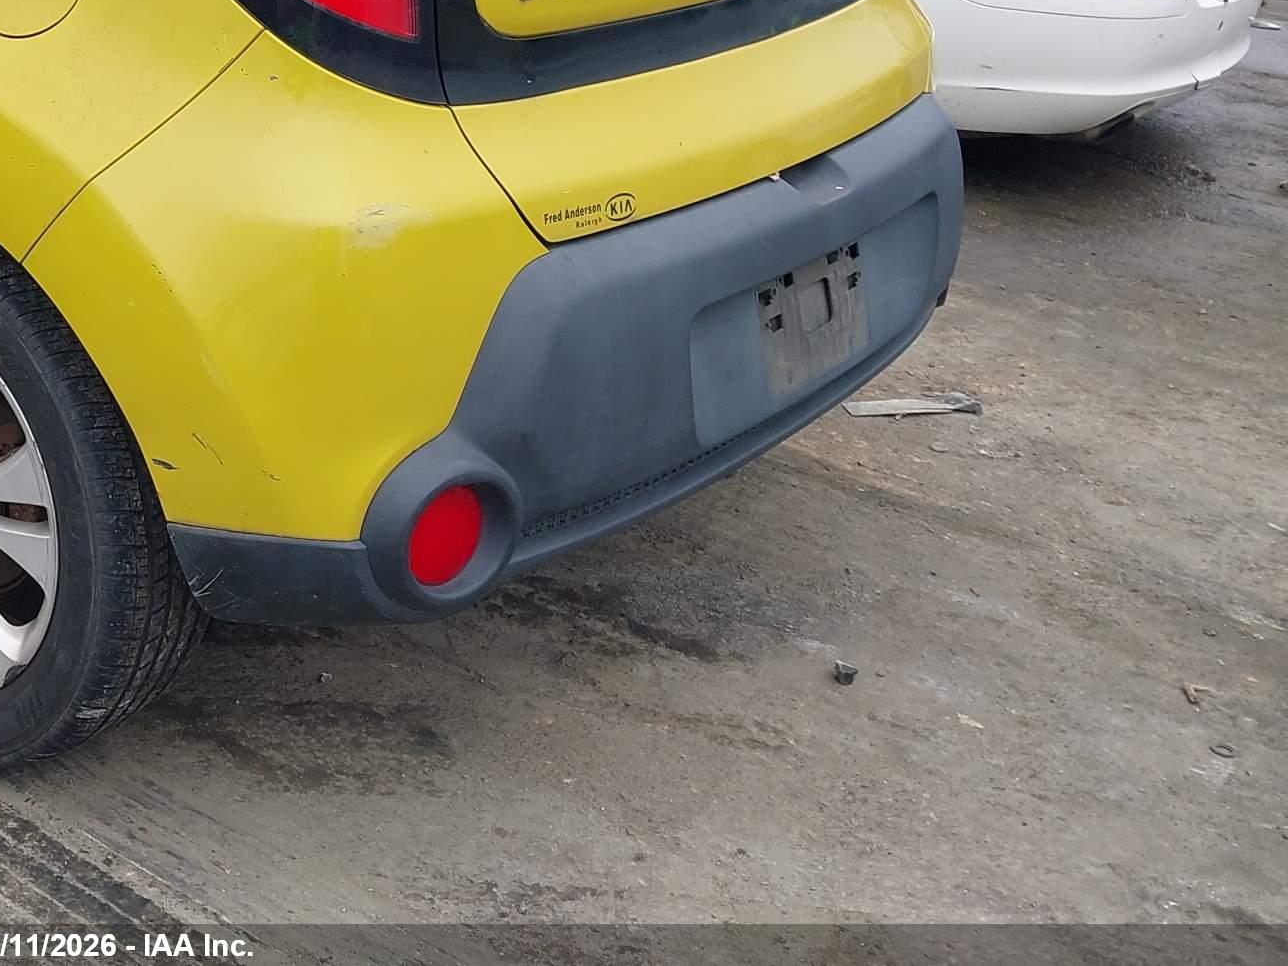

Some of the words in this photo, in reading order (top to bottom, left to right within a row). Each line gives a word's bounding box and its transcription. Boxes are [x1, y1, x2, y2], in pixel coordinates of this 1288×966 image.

[543, 209, 563, 225] Fred
[564, 203, 602, 220] Anderson
[610, 199, 632, 217] KIA
